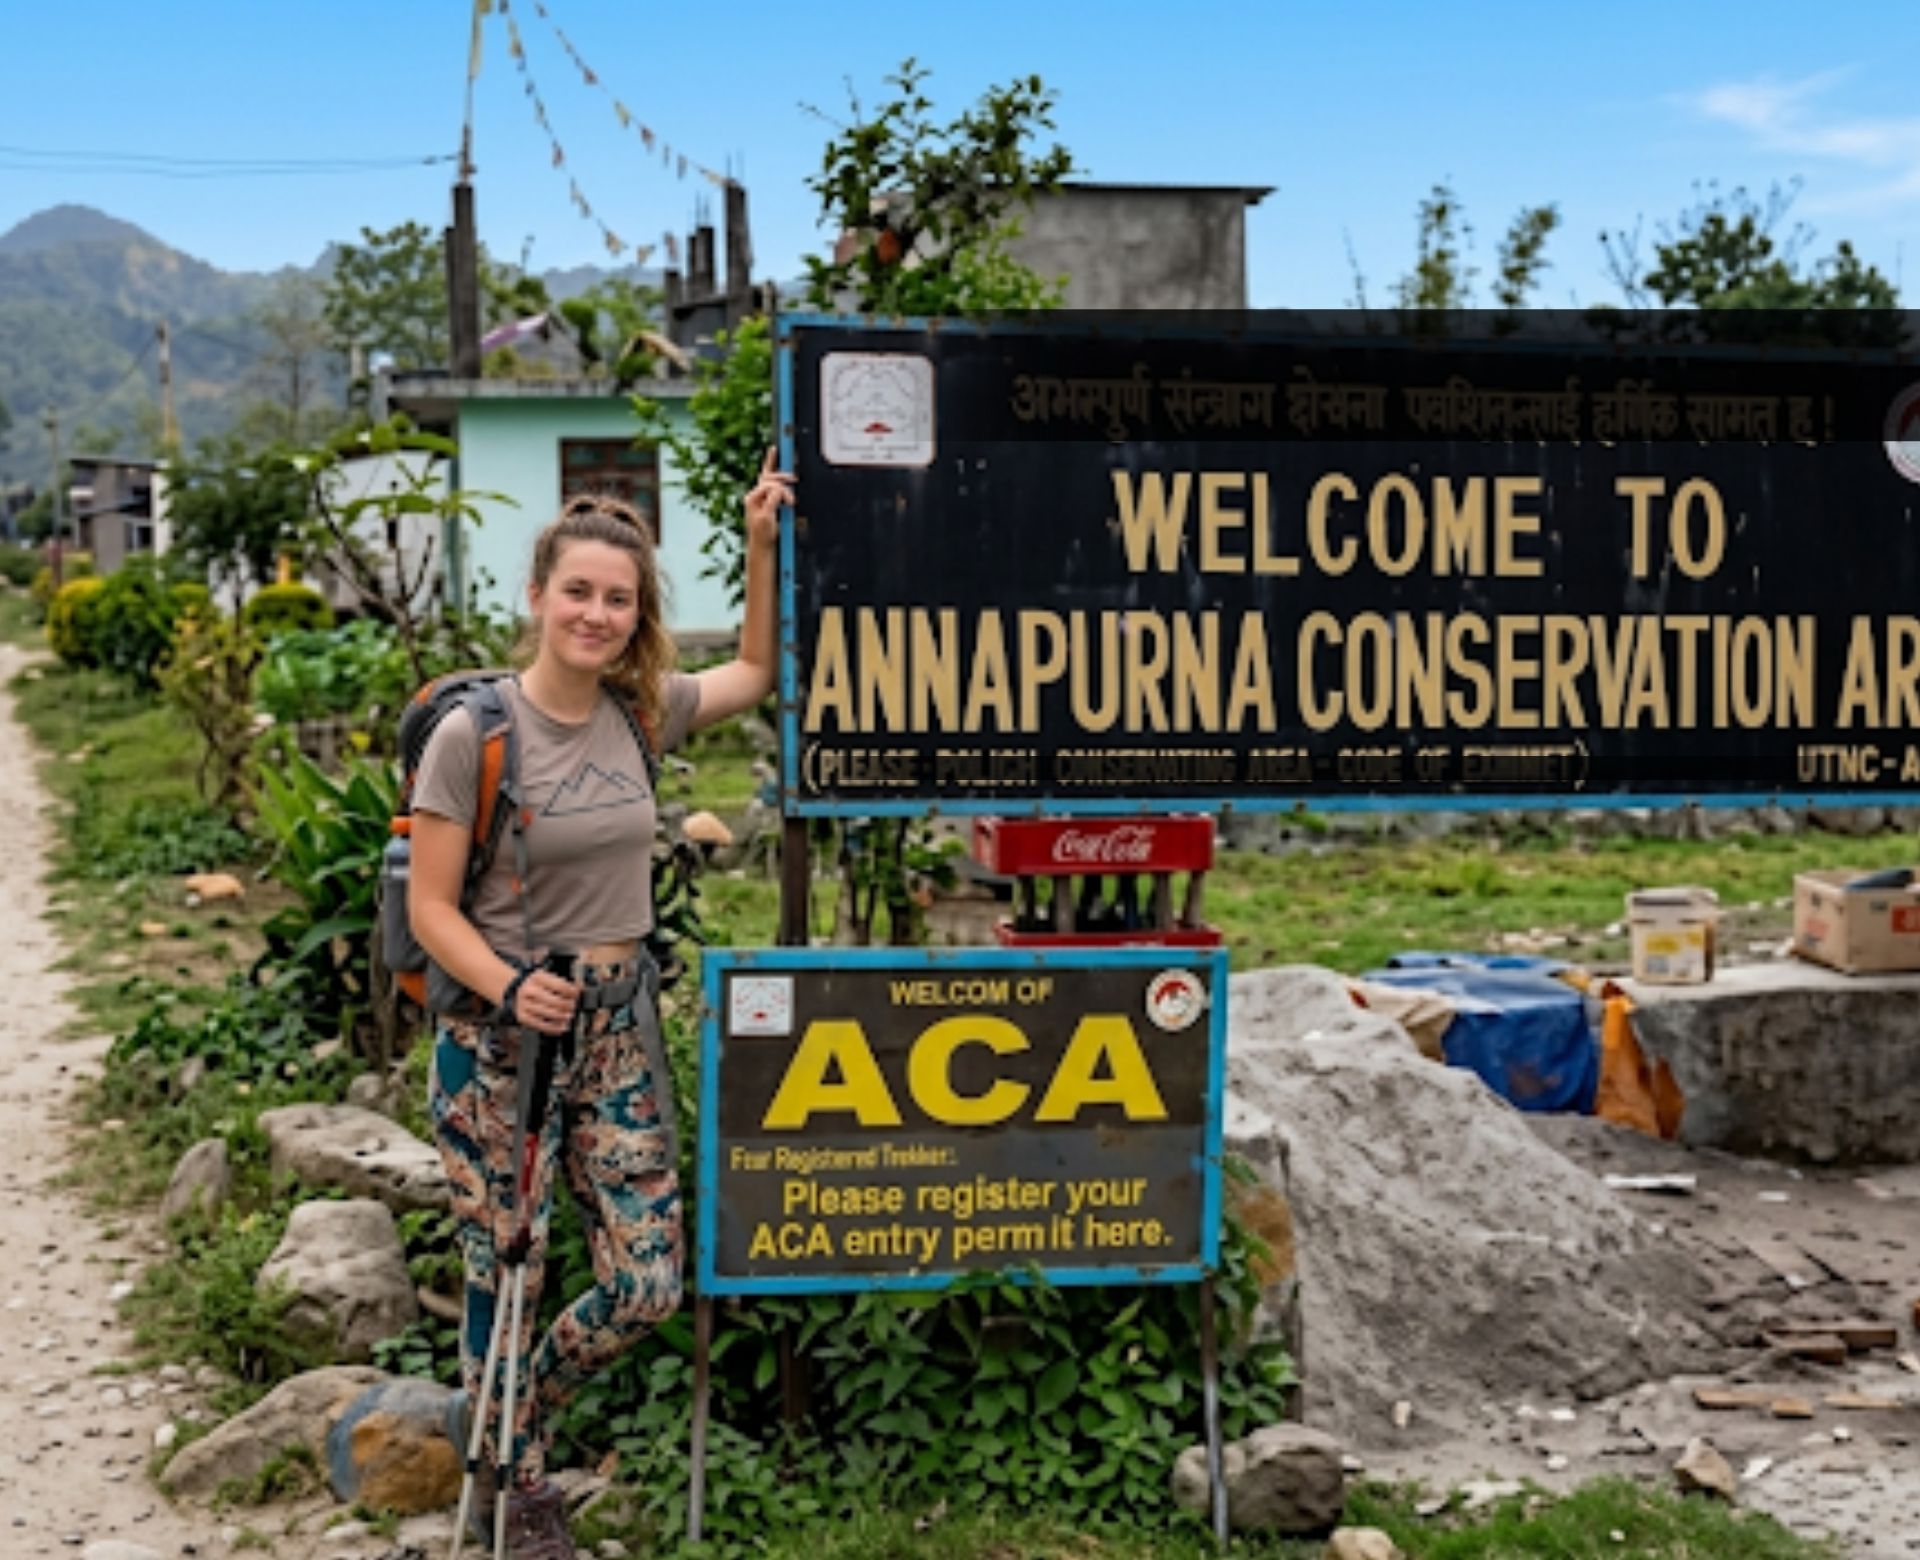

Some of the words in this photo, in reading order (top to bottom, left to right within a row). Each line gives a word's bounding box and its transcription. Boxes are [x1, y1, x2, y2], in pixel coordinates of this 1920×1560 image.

[1113, 472, 1544, 577] WELCOME
[1615, 478, 1725, 579] TO
[806, 608, 1275, 733] ANNAPURNA
[1297, 612, 1815, 731] CONSERVATION
[889, 979, 1010, 1006] WELCOM
[1016, 977, 1054, 1004] OF
[761, 1014, 1169, 1130] ACA
[783, 1179, 905, 1216] Please
[917, 1174, 1057, 1219] register
[1066, 1178, 1148, 1215] your
[749, 1221, 834, 1260] ACA
[843, 1223, 942, 1264] entry
[1085, 1214, 1173, 1248] here.
